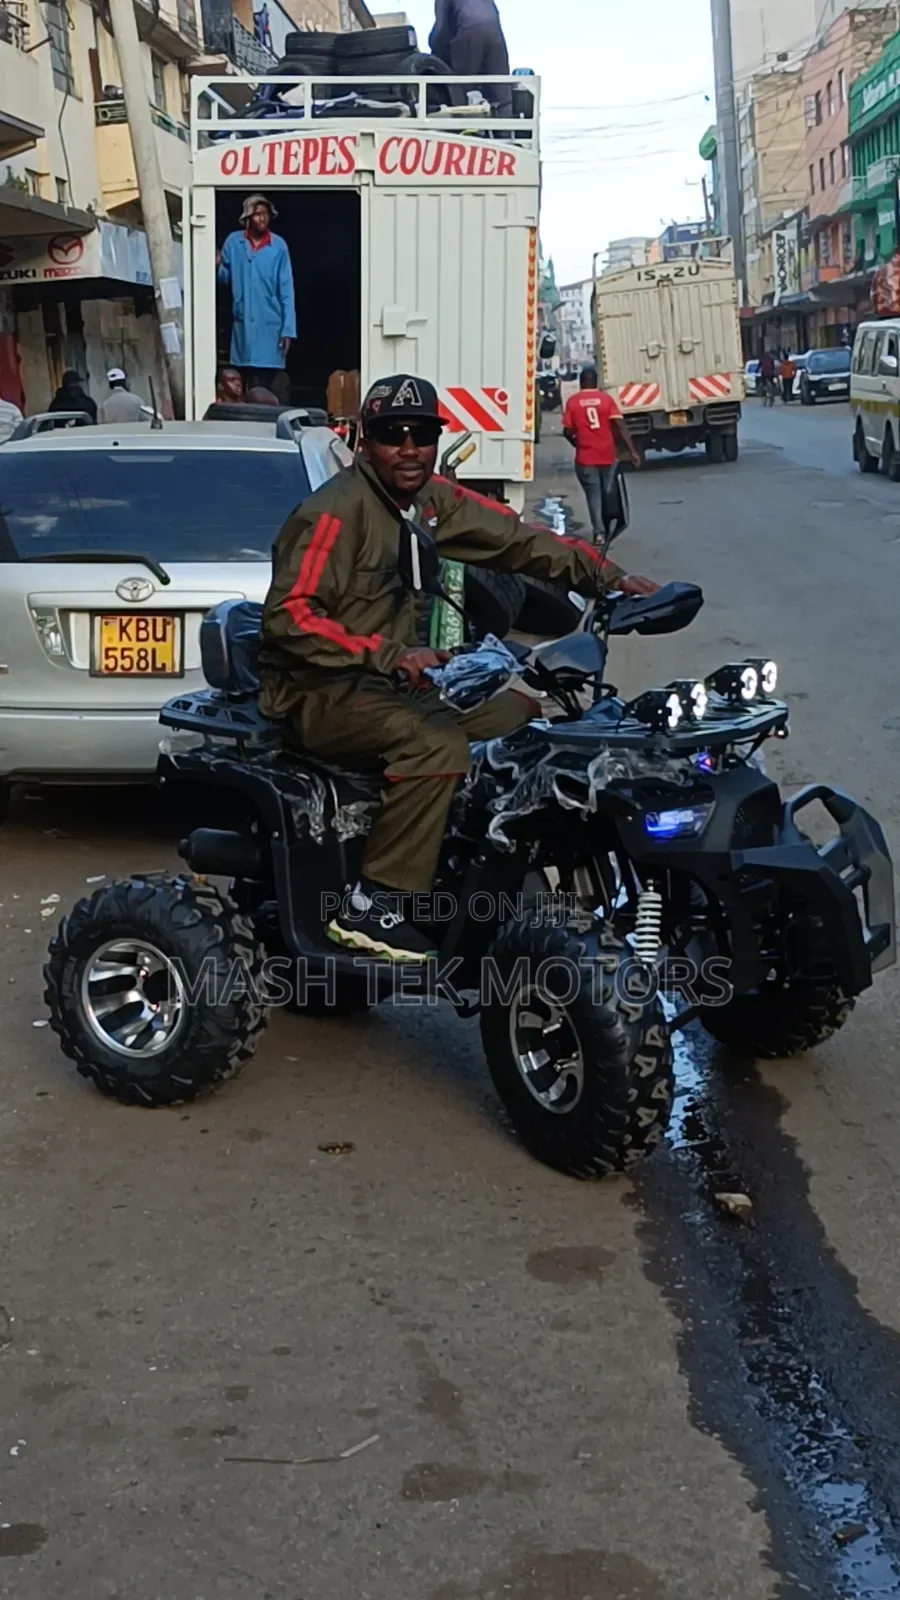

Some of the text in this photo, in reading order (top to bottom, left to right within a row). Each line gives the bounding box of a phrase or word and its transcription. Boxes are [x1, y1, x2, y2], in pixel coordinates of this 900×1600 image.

[220, 136, 516, 176] OLTEPES COURIER
[586, 406, 600, 430] 9
[119, 617, 167, 643] KBU
[104, 646, 166, 672] 558L
